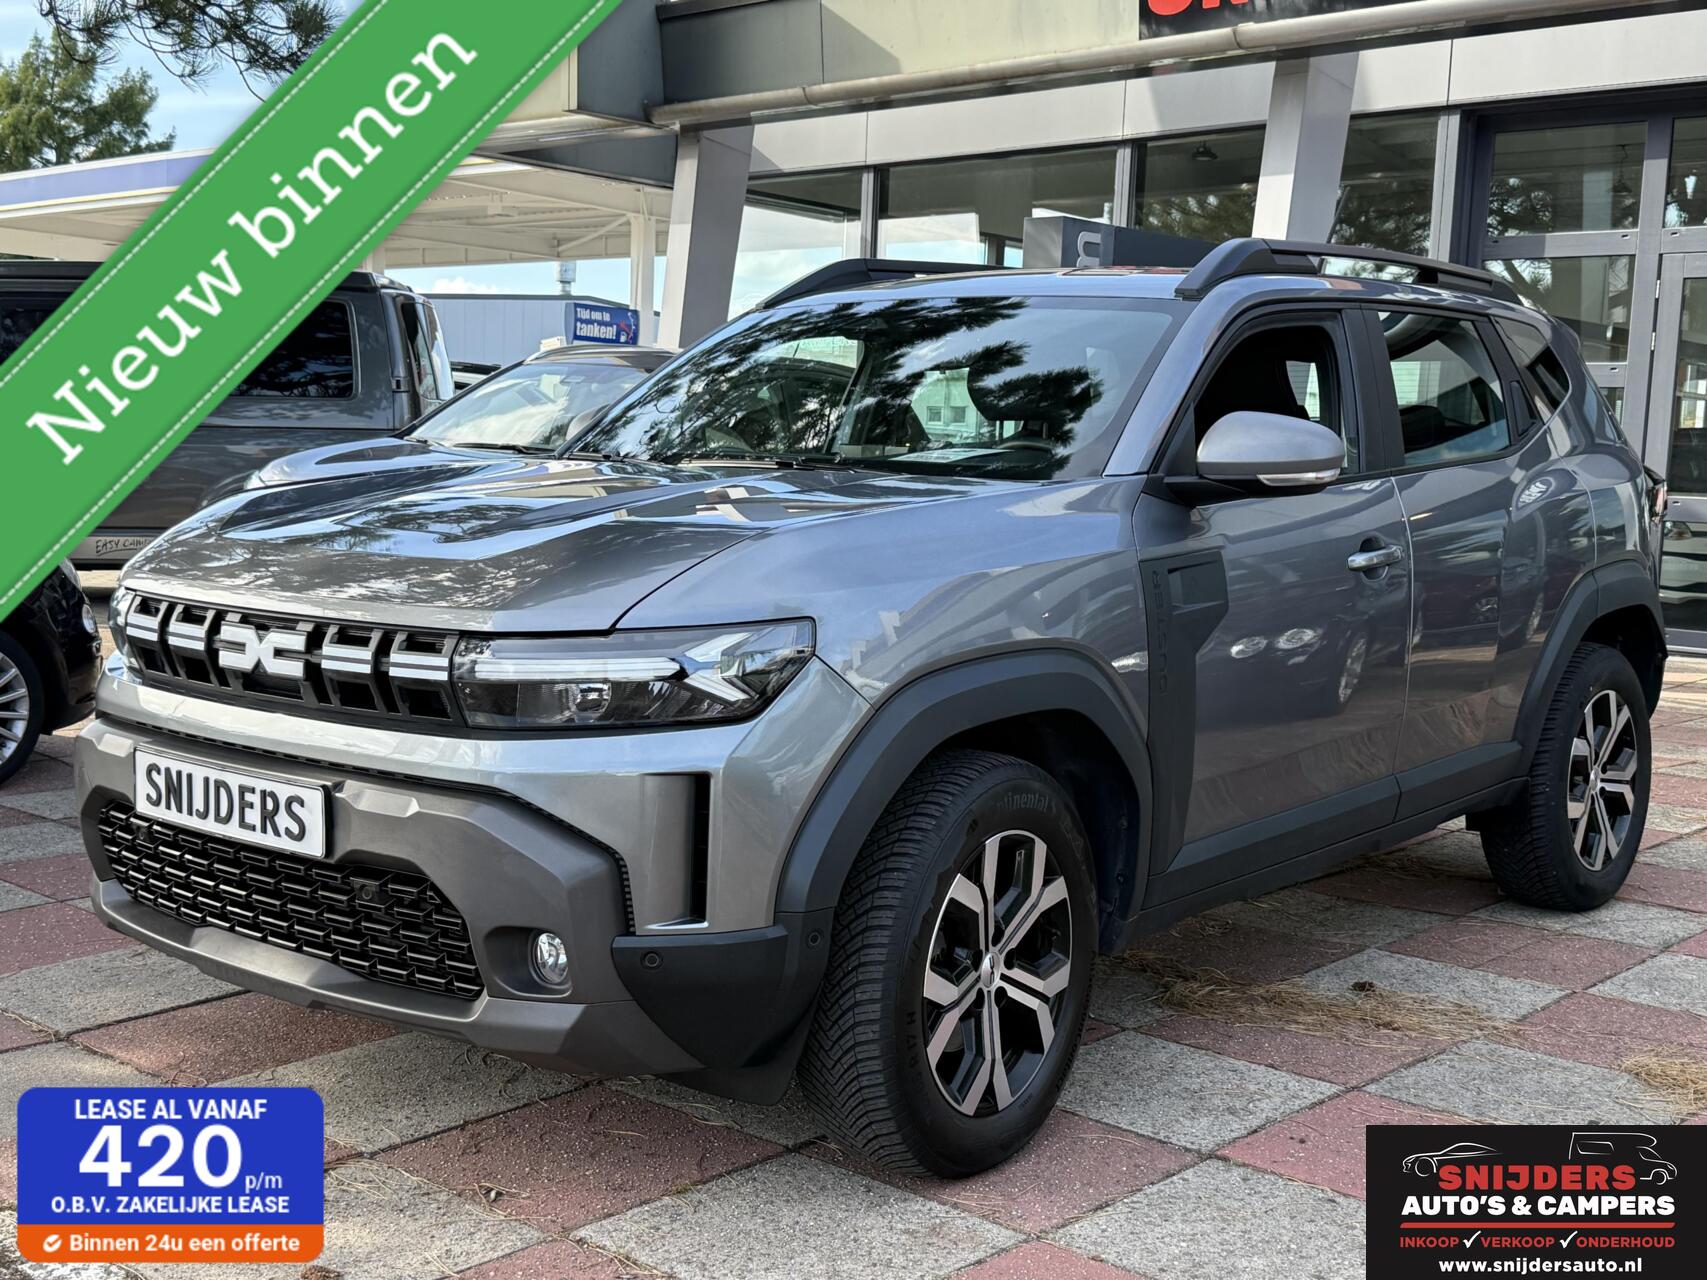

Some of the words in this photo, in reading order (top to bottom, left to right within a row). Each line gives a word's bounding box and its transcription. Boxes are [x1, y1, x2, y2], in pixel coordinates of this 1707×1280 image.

[576, 307, 590, 320] Tijd
[591, 311, 602, 320] om
[576, 321, 617, 340] tanken!
[146, 763, 306, 842] SNIJDERS
